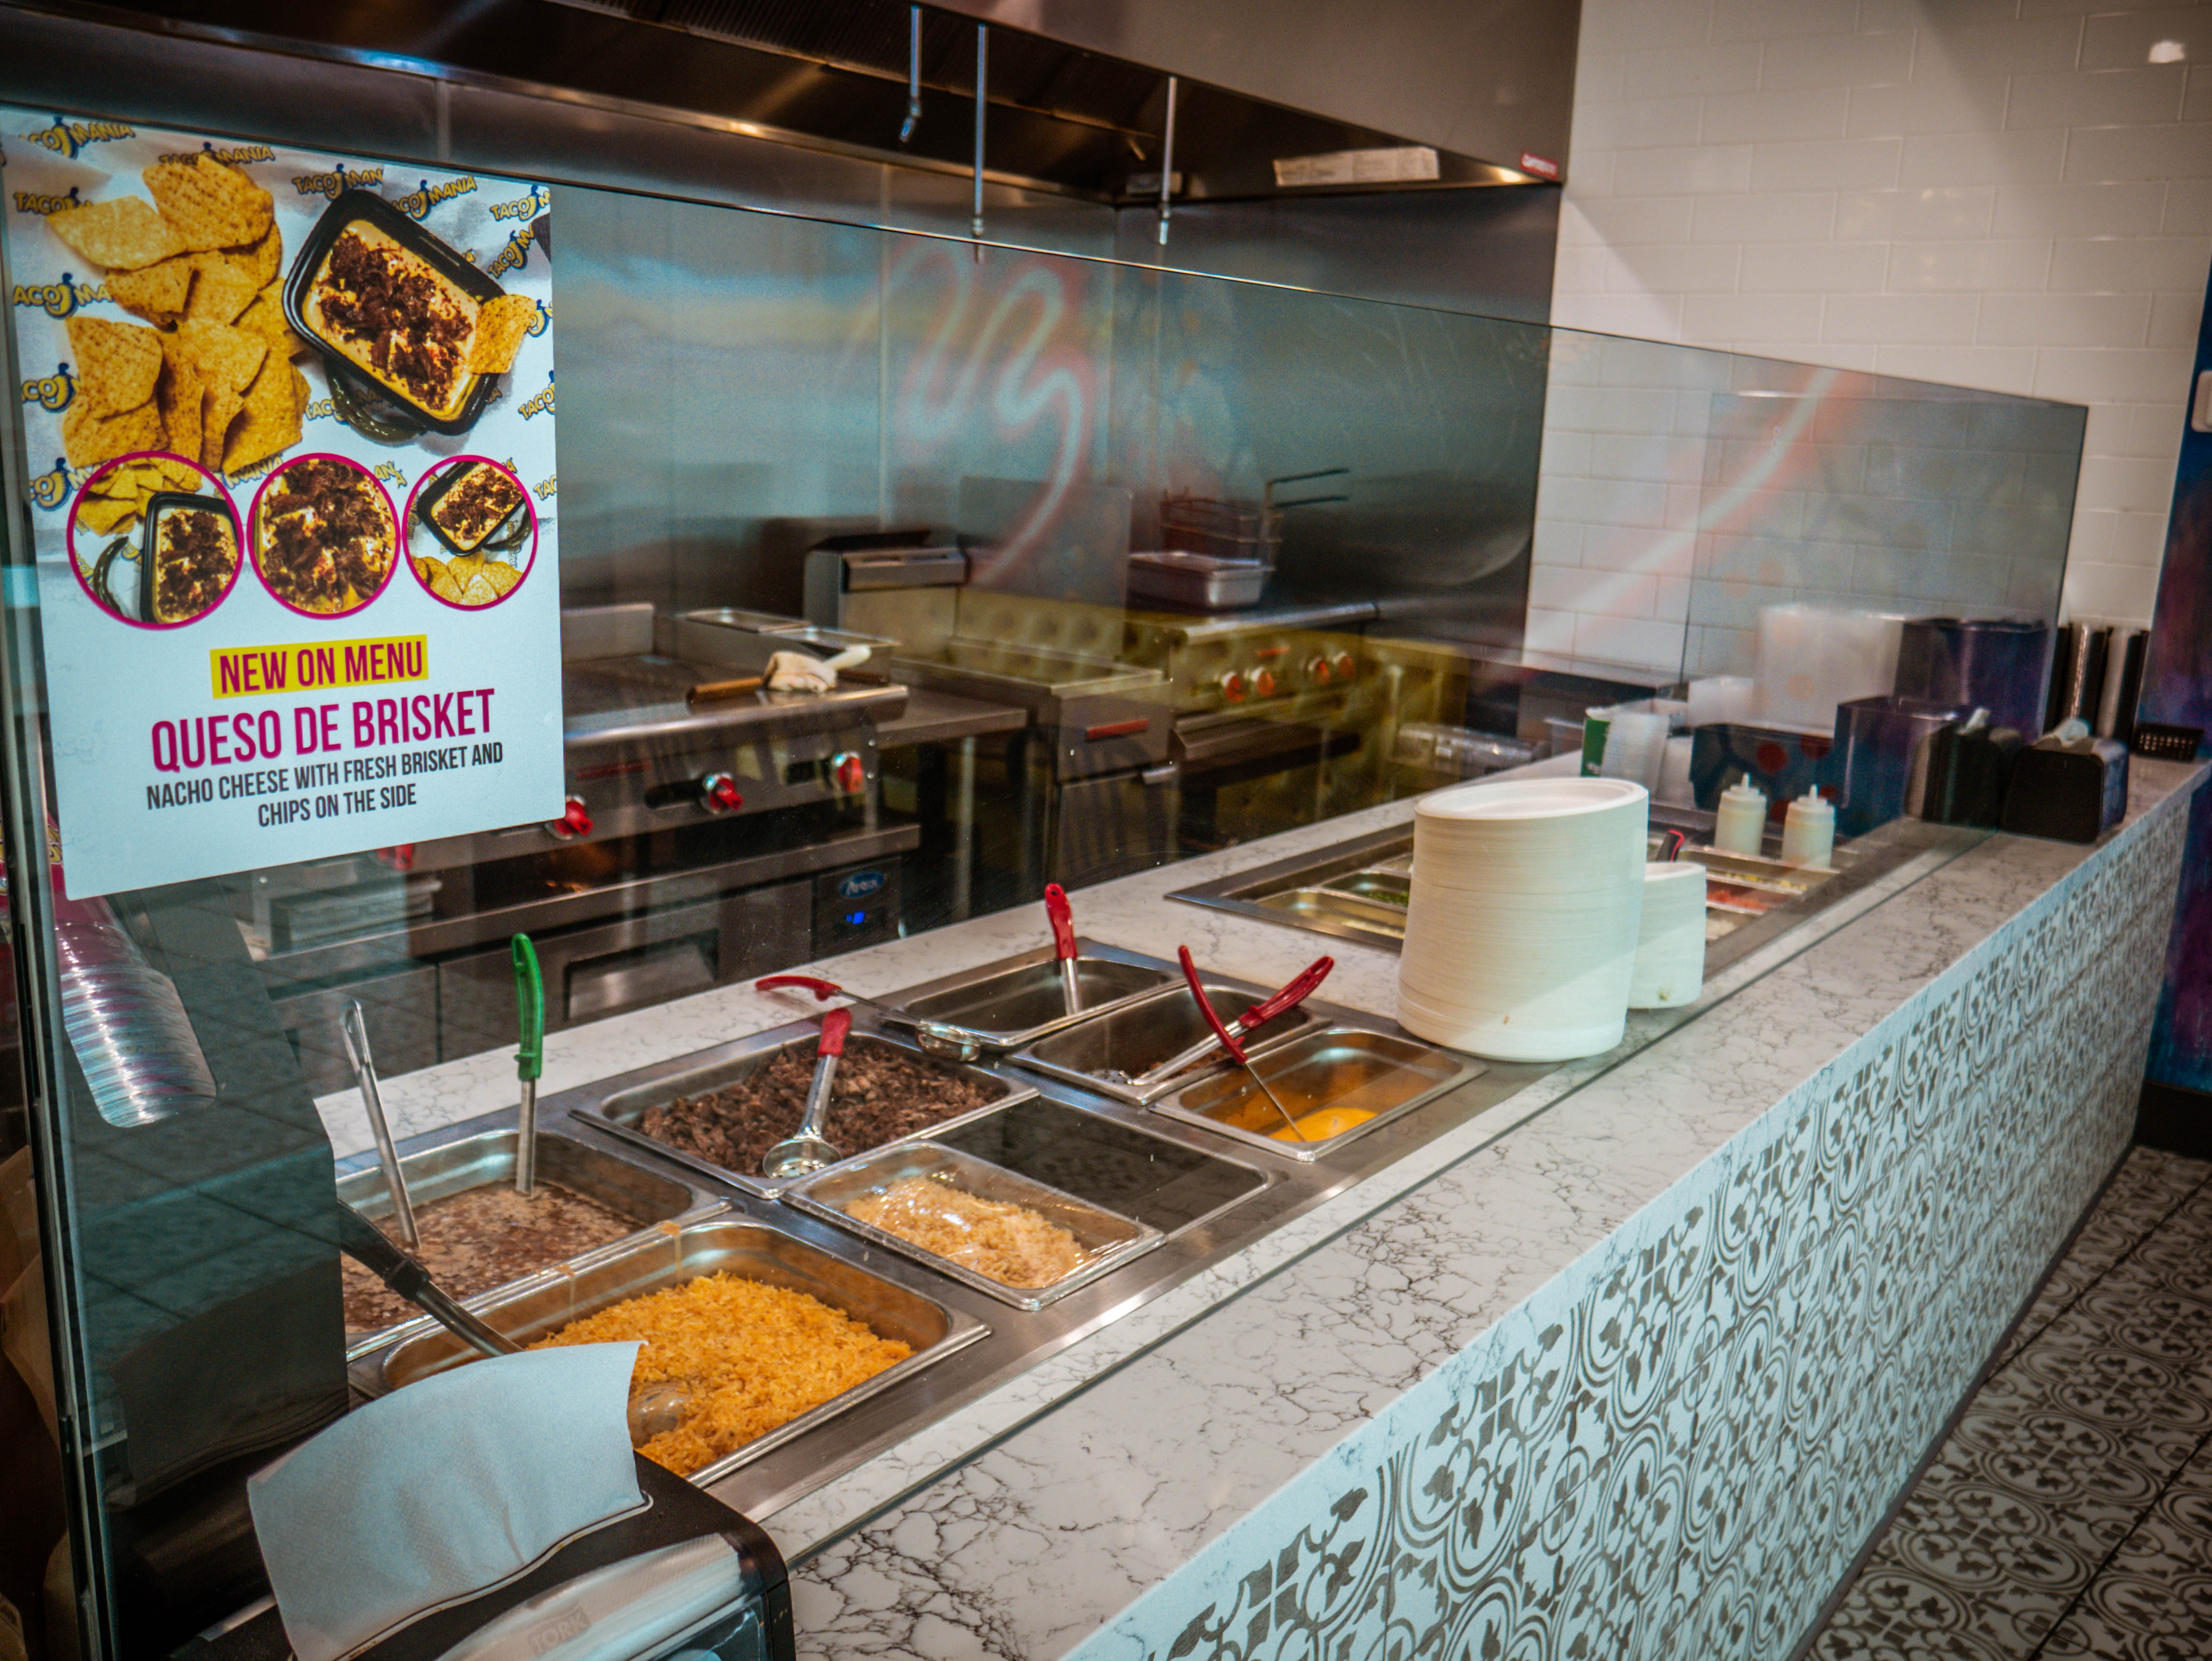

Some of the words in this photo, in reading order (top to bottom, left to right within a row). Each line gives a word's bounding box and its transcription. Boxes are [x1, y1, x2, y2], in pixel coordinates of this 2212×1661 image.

[69, 122, 136, 147] MANIA
[428, 176, 478, 205] MANIA
[13, 284, 61, 308] ACO
[219, 650, 288, 694] NEW
[297, 648, 336, 687] ON
[344, 641, 423, 683] MENU
[151, 710, 282, 773] QUESO
[294, 704, 342, 756] DE
[352, 688, 495, 748] BRISKET
[146, 778, 214, 810] NACHO
[218, 769, 289, 800] CHEESE
[294, 762, 339, 790] WITH
[344, 757, 397, 784] FRESH
[401, 747, 467, 775] BRISKET
[471, 742, 503, 766] AND
[258, 797, 311, 827] CHIPS
[315, 796, 340, 818] ON
[343, 791, 376, 813] THE
[380, 784, 417, 809] SIDE
